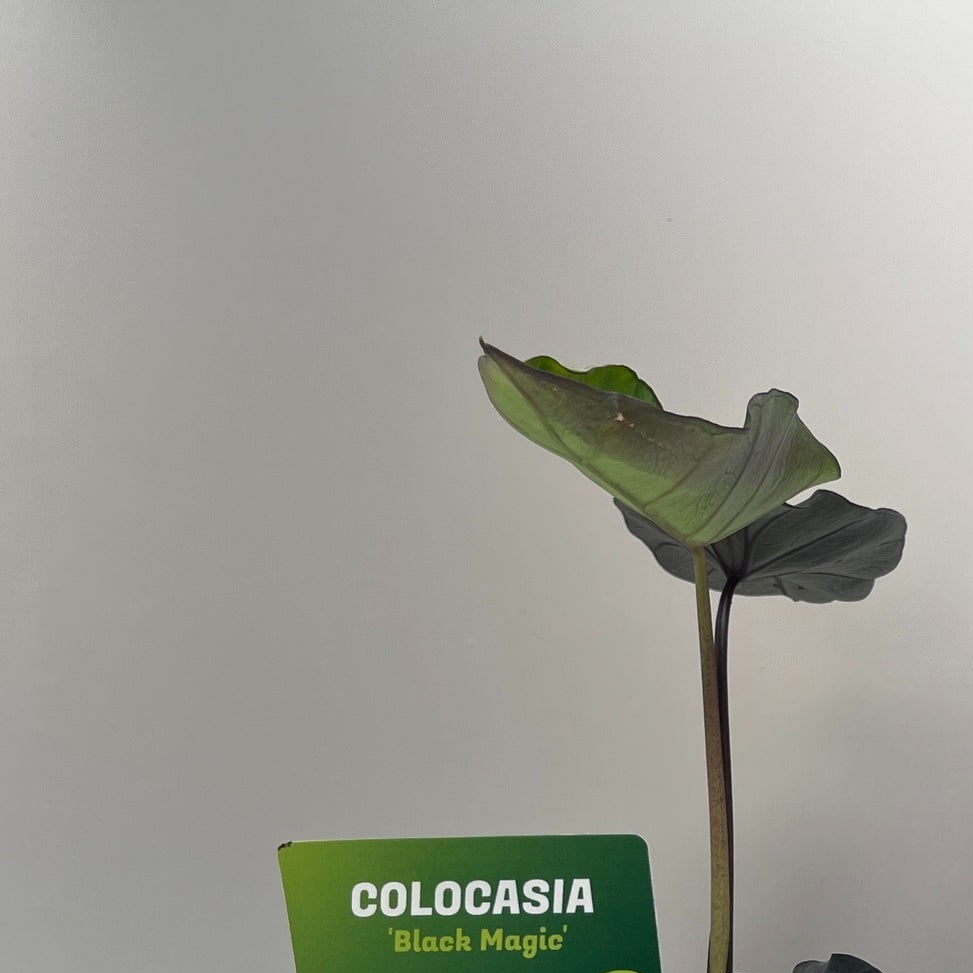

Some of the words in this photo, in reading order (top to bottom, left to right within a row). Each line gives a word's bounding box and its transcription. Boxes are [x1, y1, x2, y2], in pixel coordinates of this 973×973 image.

[350, 878, 595, 918] COLOCASIA
[388, 926, 472, 953] 'Black
[480, 924, 569, 958] Magic'
